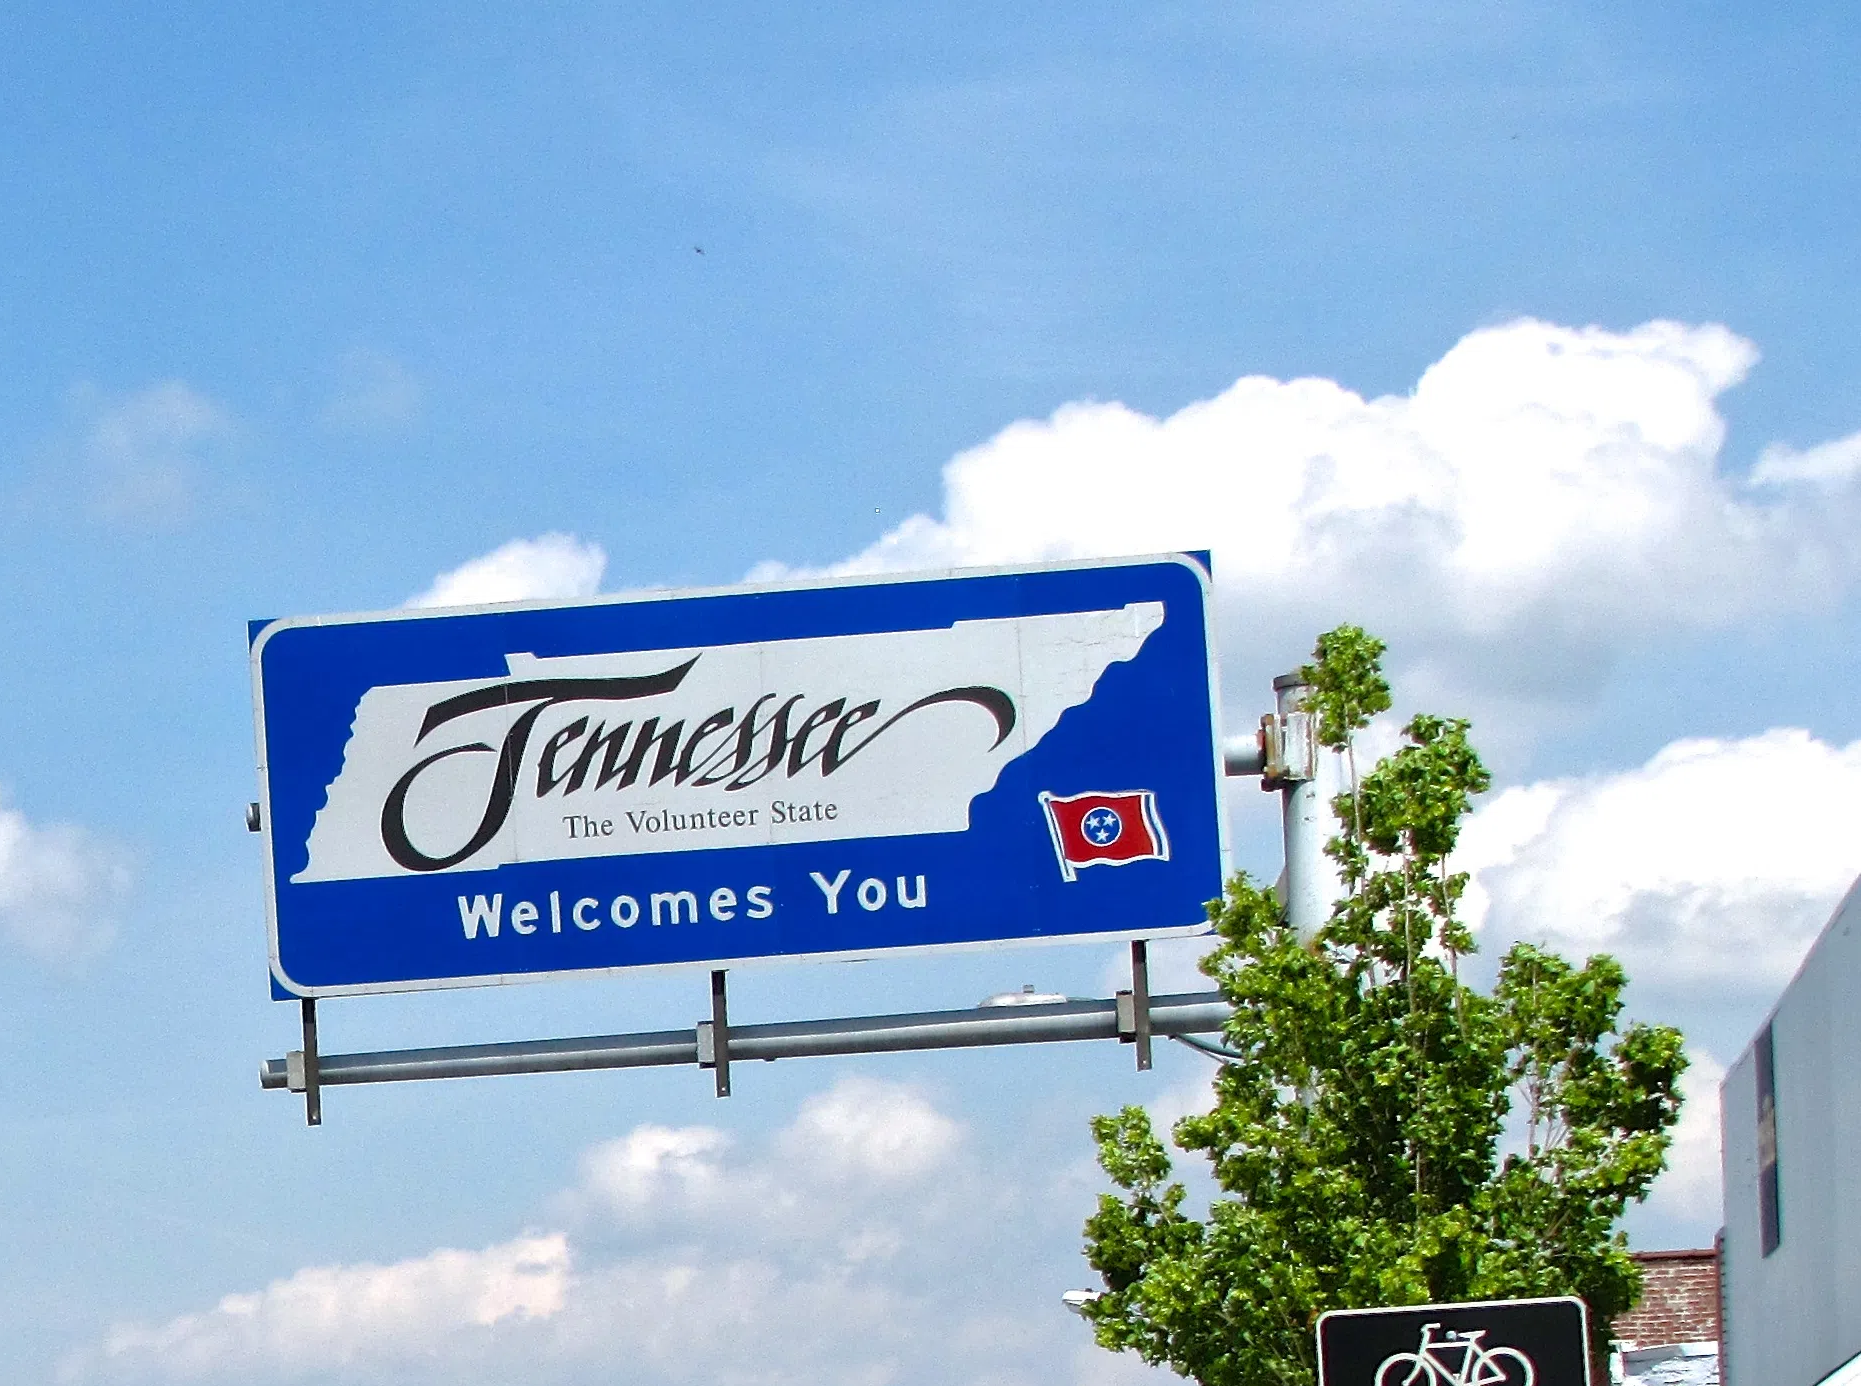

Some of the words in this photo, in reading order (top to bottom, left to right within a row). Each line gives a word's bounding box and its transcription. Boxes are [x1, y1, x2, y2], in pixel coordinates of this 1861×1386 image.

[380, 652, 1017, 872] Tennessee
[563, 814, 615, 840] The
[625, 804, 760, 834] Volunteer
[770, 799, 839, 825] State
[457, 882, 774, 941] Welcomes
[809, 868, 928, 916] You
